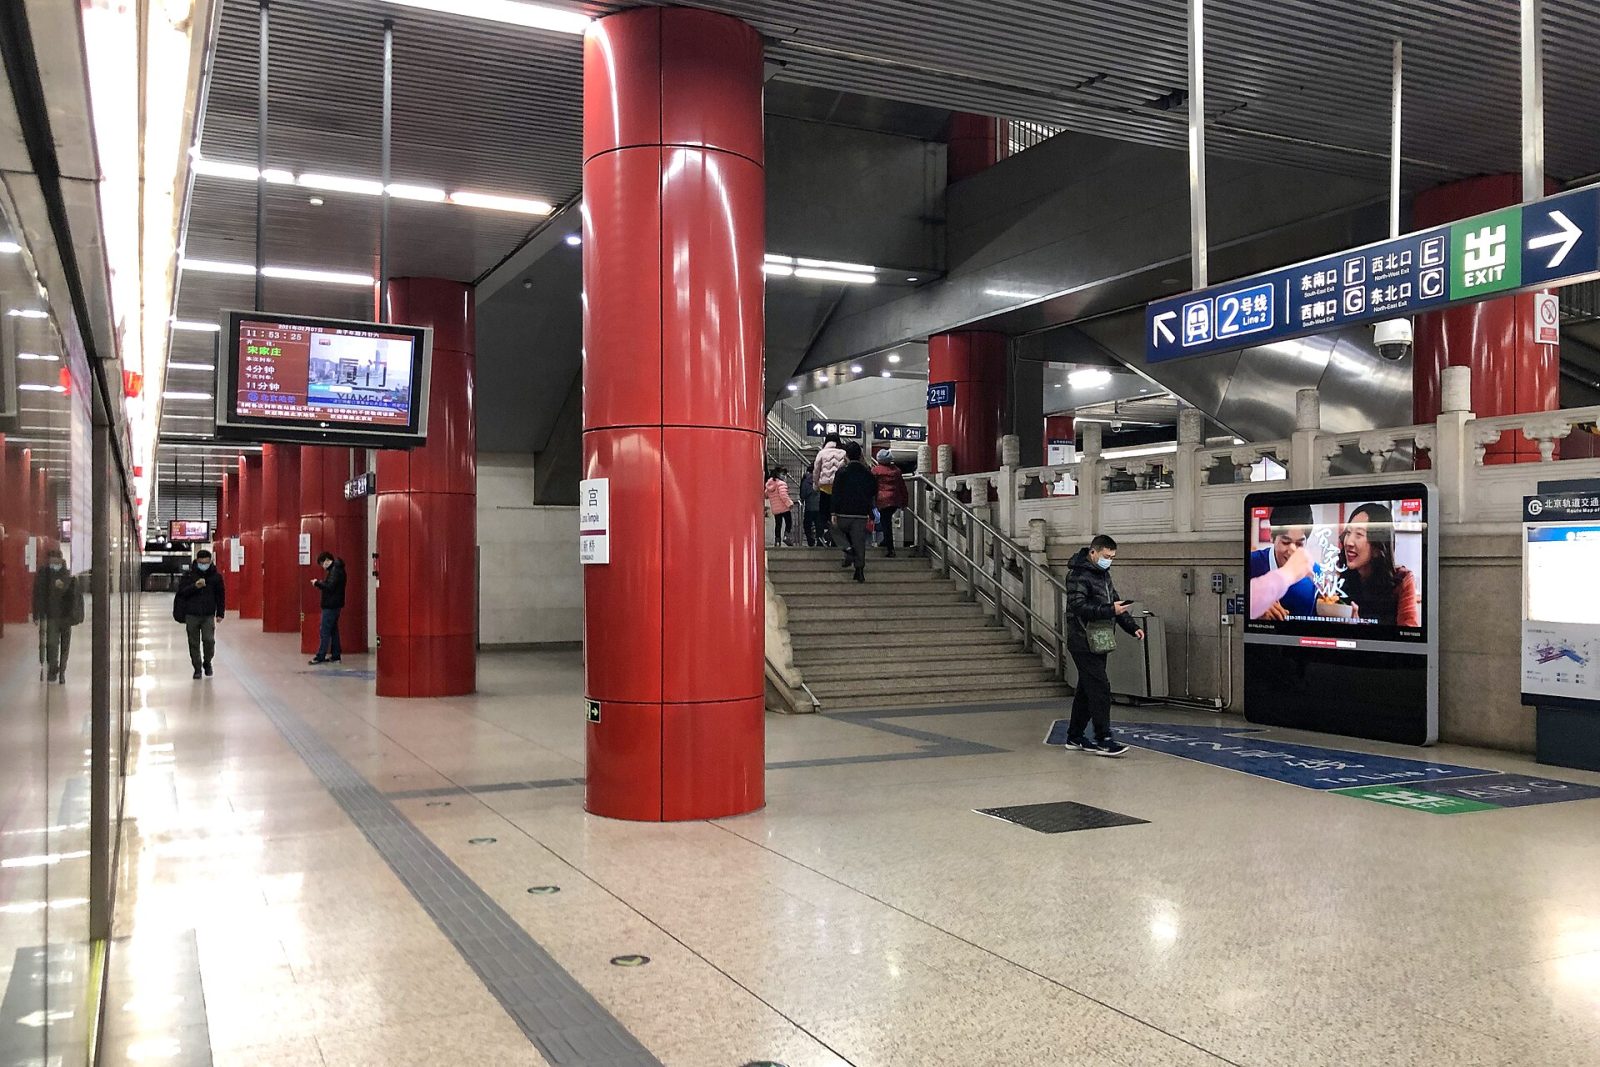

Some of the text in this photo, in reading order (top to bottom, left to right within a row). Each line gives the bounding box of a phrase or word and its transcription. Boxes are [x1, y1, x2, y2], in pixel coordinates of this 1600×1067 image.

[1371, 250, 1412, 274] 西北口
[1423, 240, 1439, 264] E
[1301, 269, 1338, 291] 东南口
[1347, 260, 1361, 283] F
[1464, 264, 1506, 288] EXIT
[1371, 282, 1412, 305] 东北口
[1422, 271, 1440, 295] C
[1301, 299, 1338, 321] 西南口
[1345, 289, 1362, 312] G
[1221, 293, 1268, 334] 2号线
[1242, 312, 1266, 326] Line 2
[247, 345, 282, 357] 宋家庄
[245, 365, 275, 375] 4分钟
[246, 382, 280, 392] 11分钟
[1544, 497, 1599, 509] 北京轨道交通
[1314, 776, 1358, 784] To
[1357, 770, 1425, 782] Line
